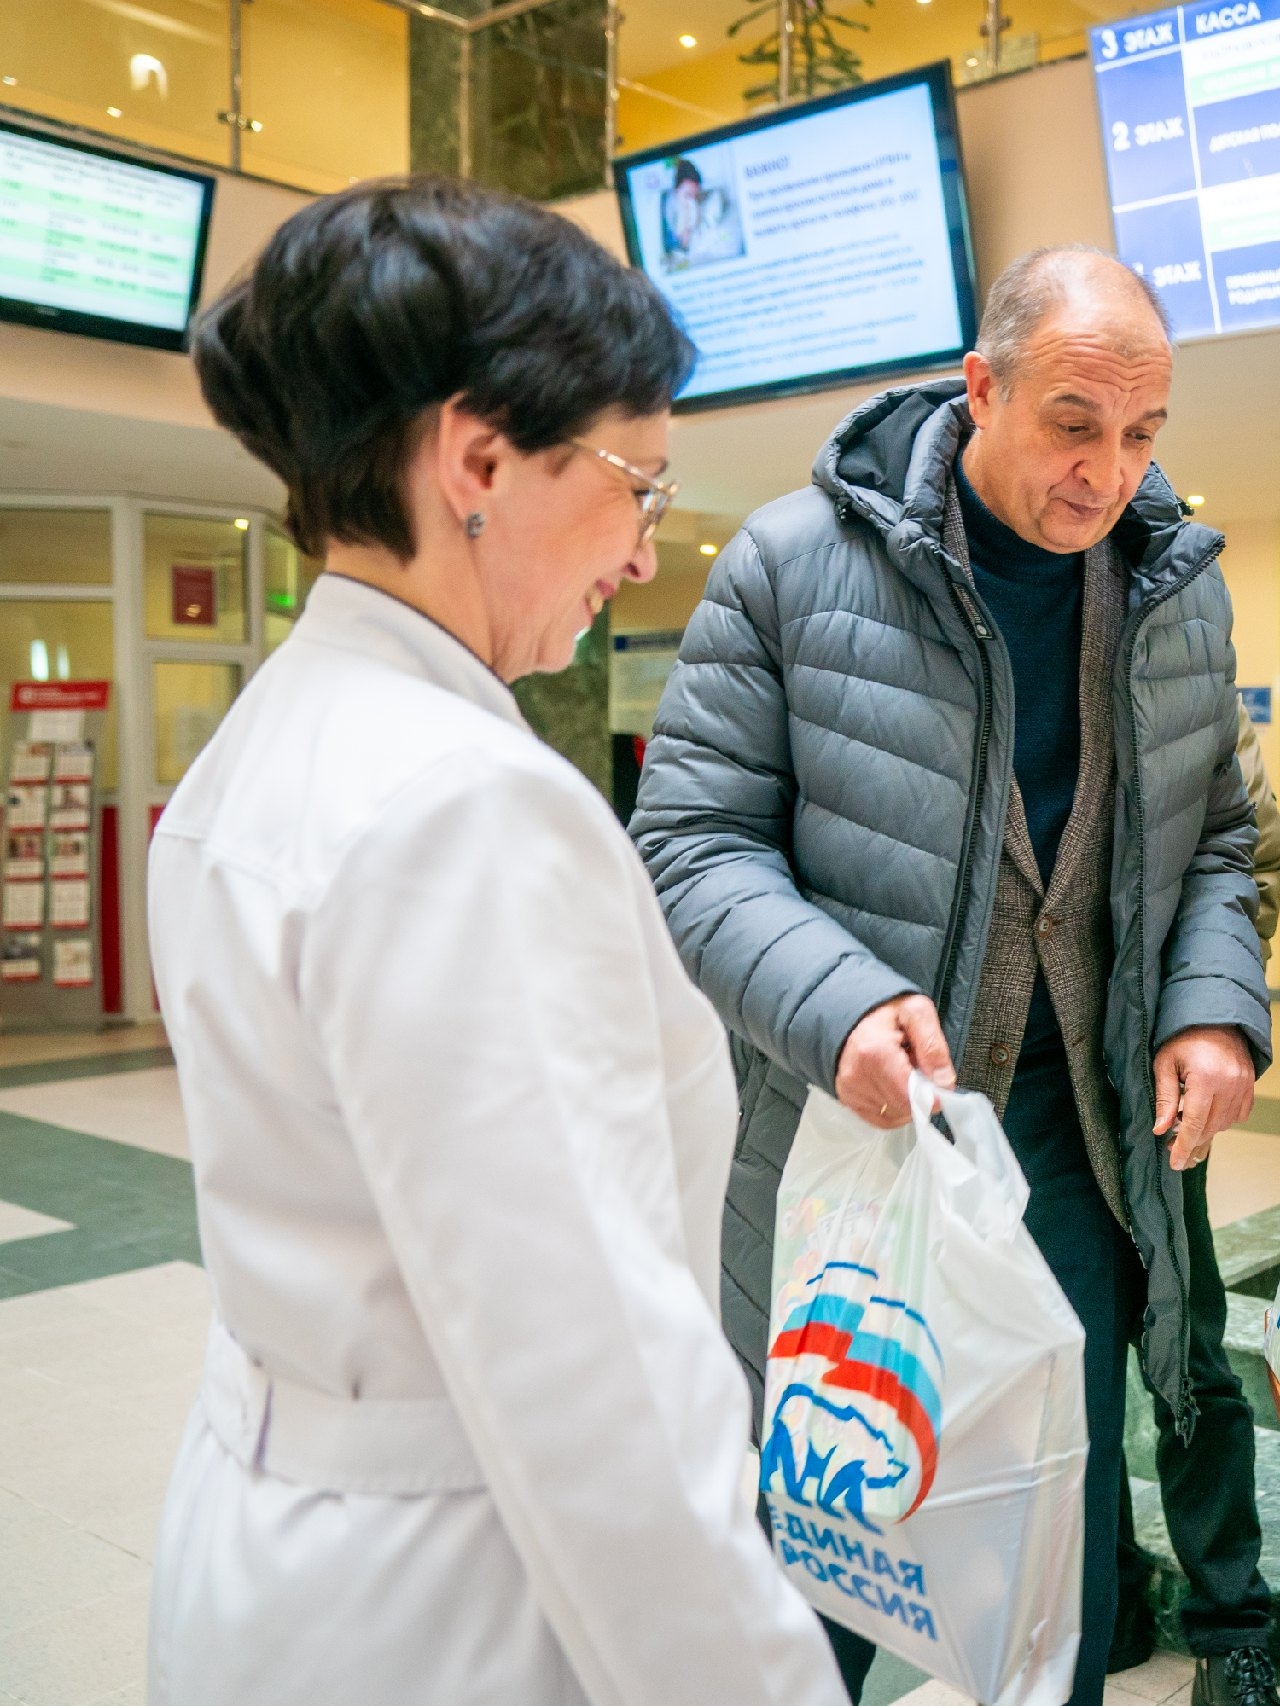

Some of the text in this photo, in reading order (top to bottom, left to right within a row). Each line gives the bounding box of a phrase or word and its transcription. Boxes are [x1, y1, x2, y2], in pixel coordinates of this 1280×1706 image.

[1195, 1, 1261, 34] КАССА
[1101, 29, 1119, 59] 3
[1123, 22, 1174, 54] ЭТАЖ
[1111, 116, 1184, 152] 2 ЭТАЖ
[1152, 260, 1202, 288] ЭТАЖ
